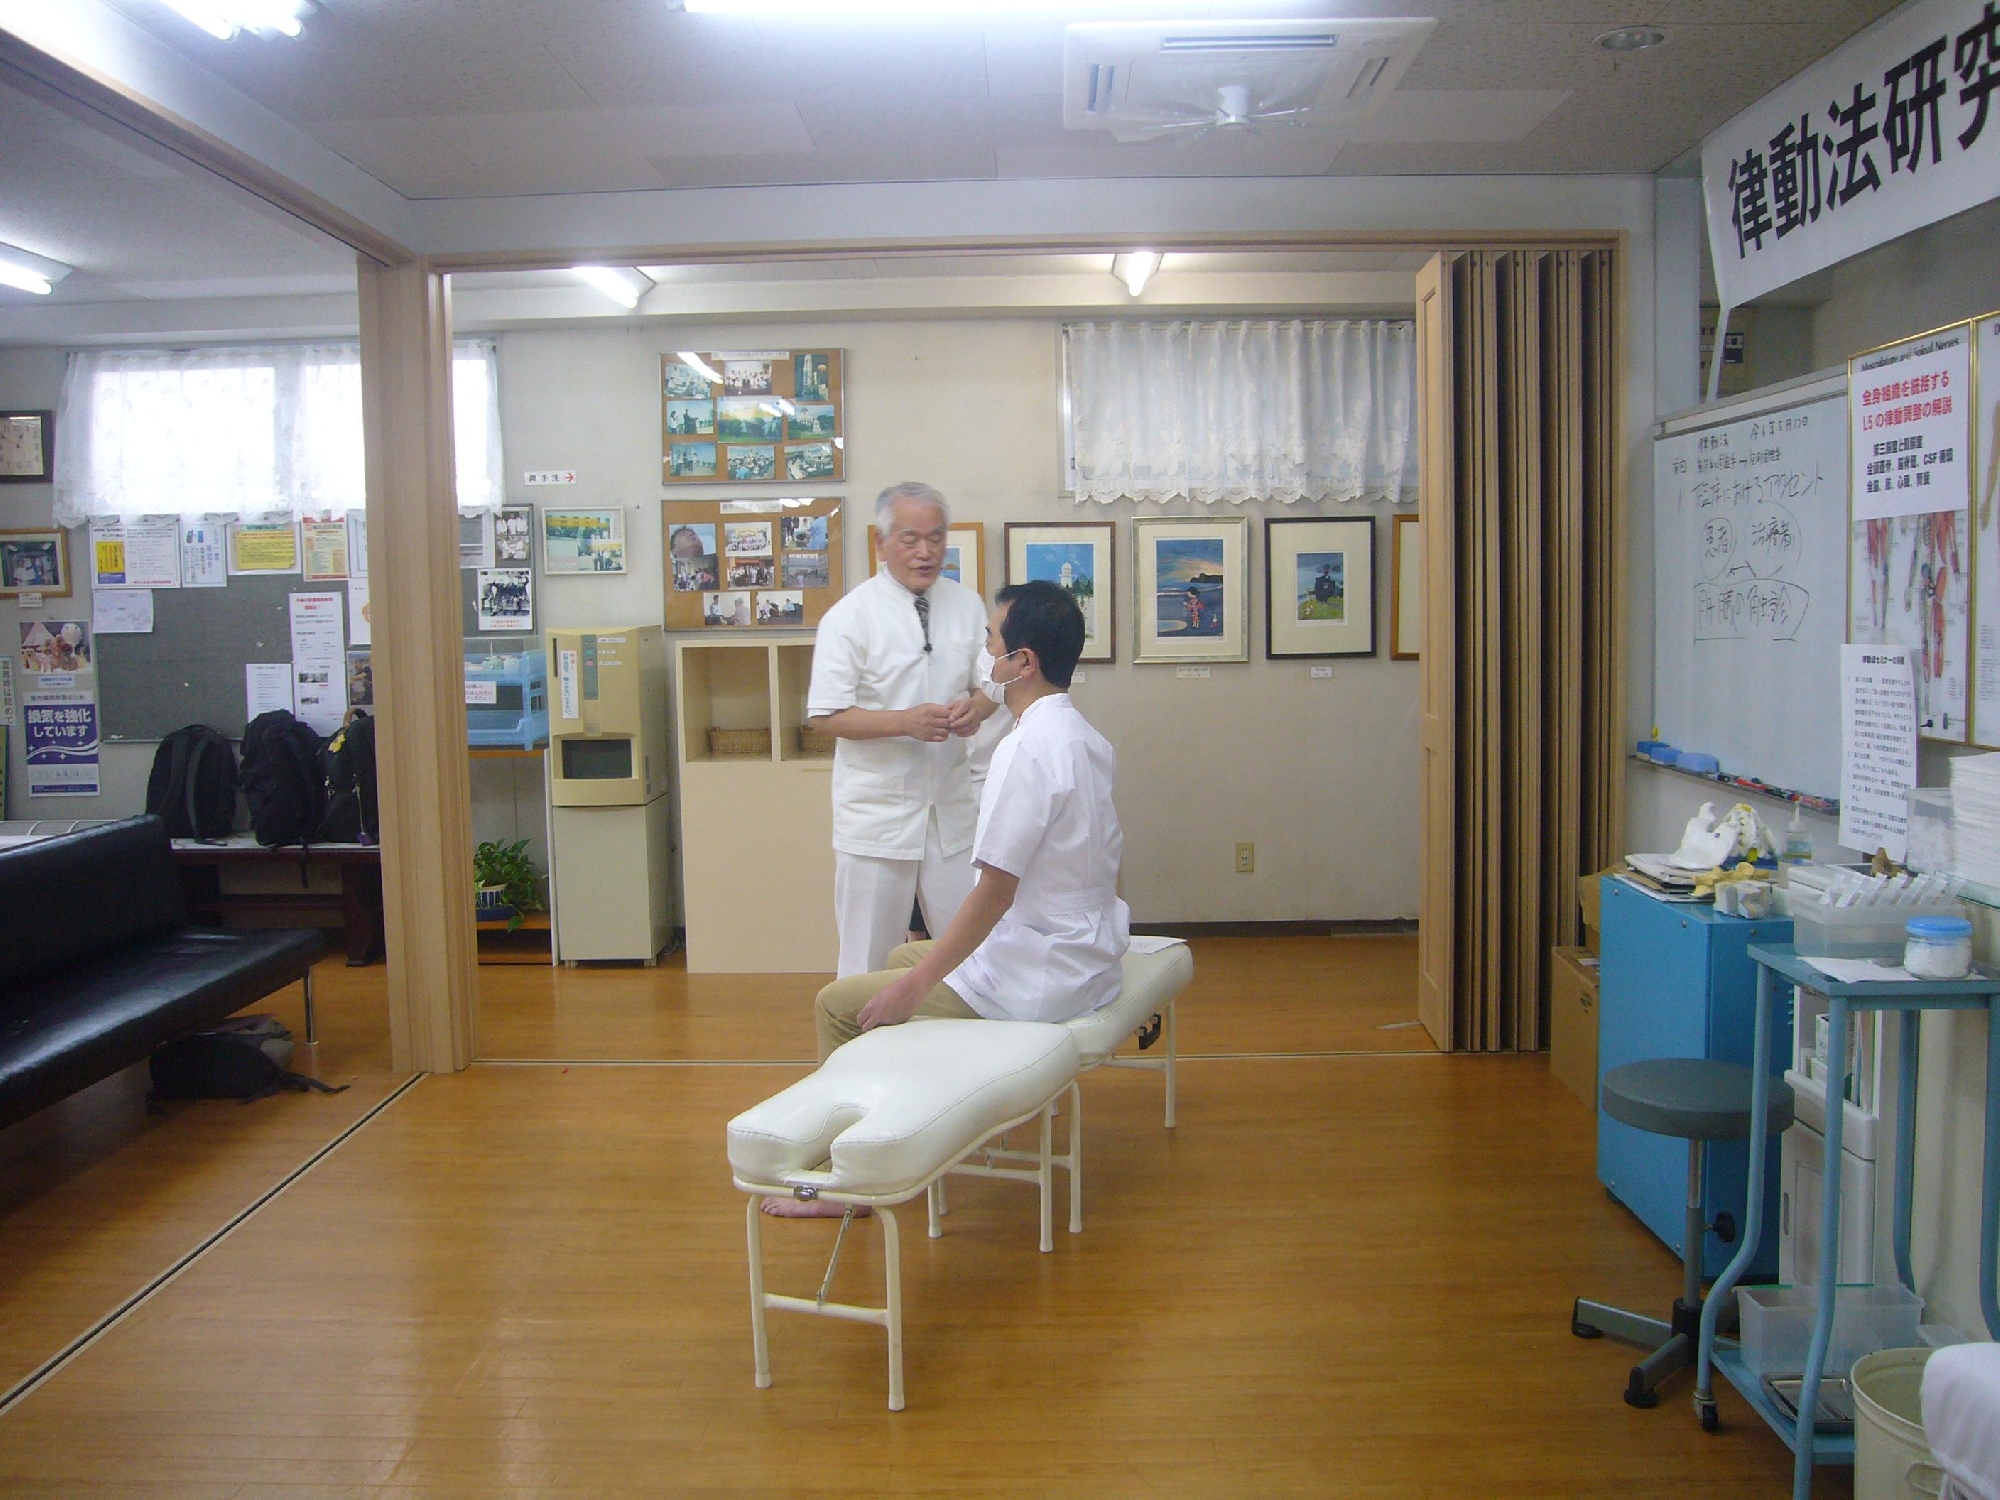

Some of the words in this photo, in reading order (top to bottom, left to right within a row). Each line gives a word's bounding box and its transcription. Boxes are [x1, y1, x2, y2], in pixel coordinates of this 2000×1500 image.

[1936, 337, 1959, 351] Nerves
[1862, 370, 1949, 406] 全身組織を統括する
[28, 708, 92, 723] 換気を強化
[33, 724, 88, 738] しています
